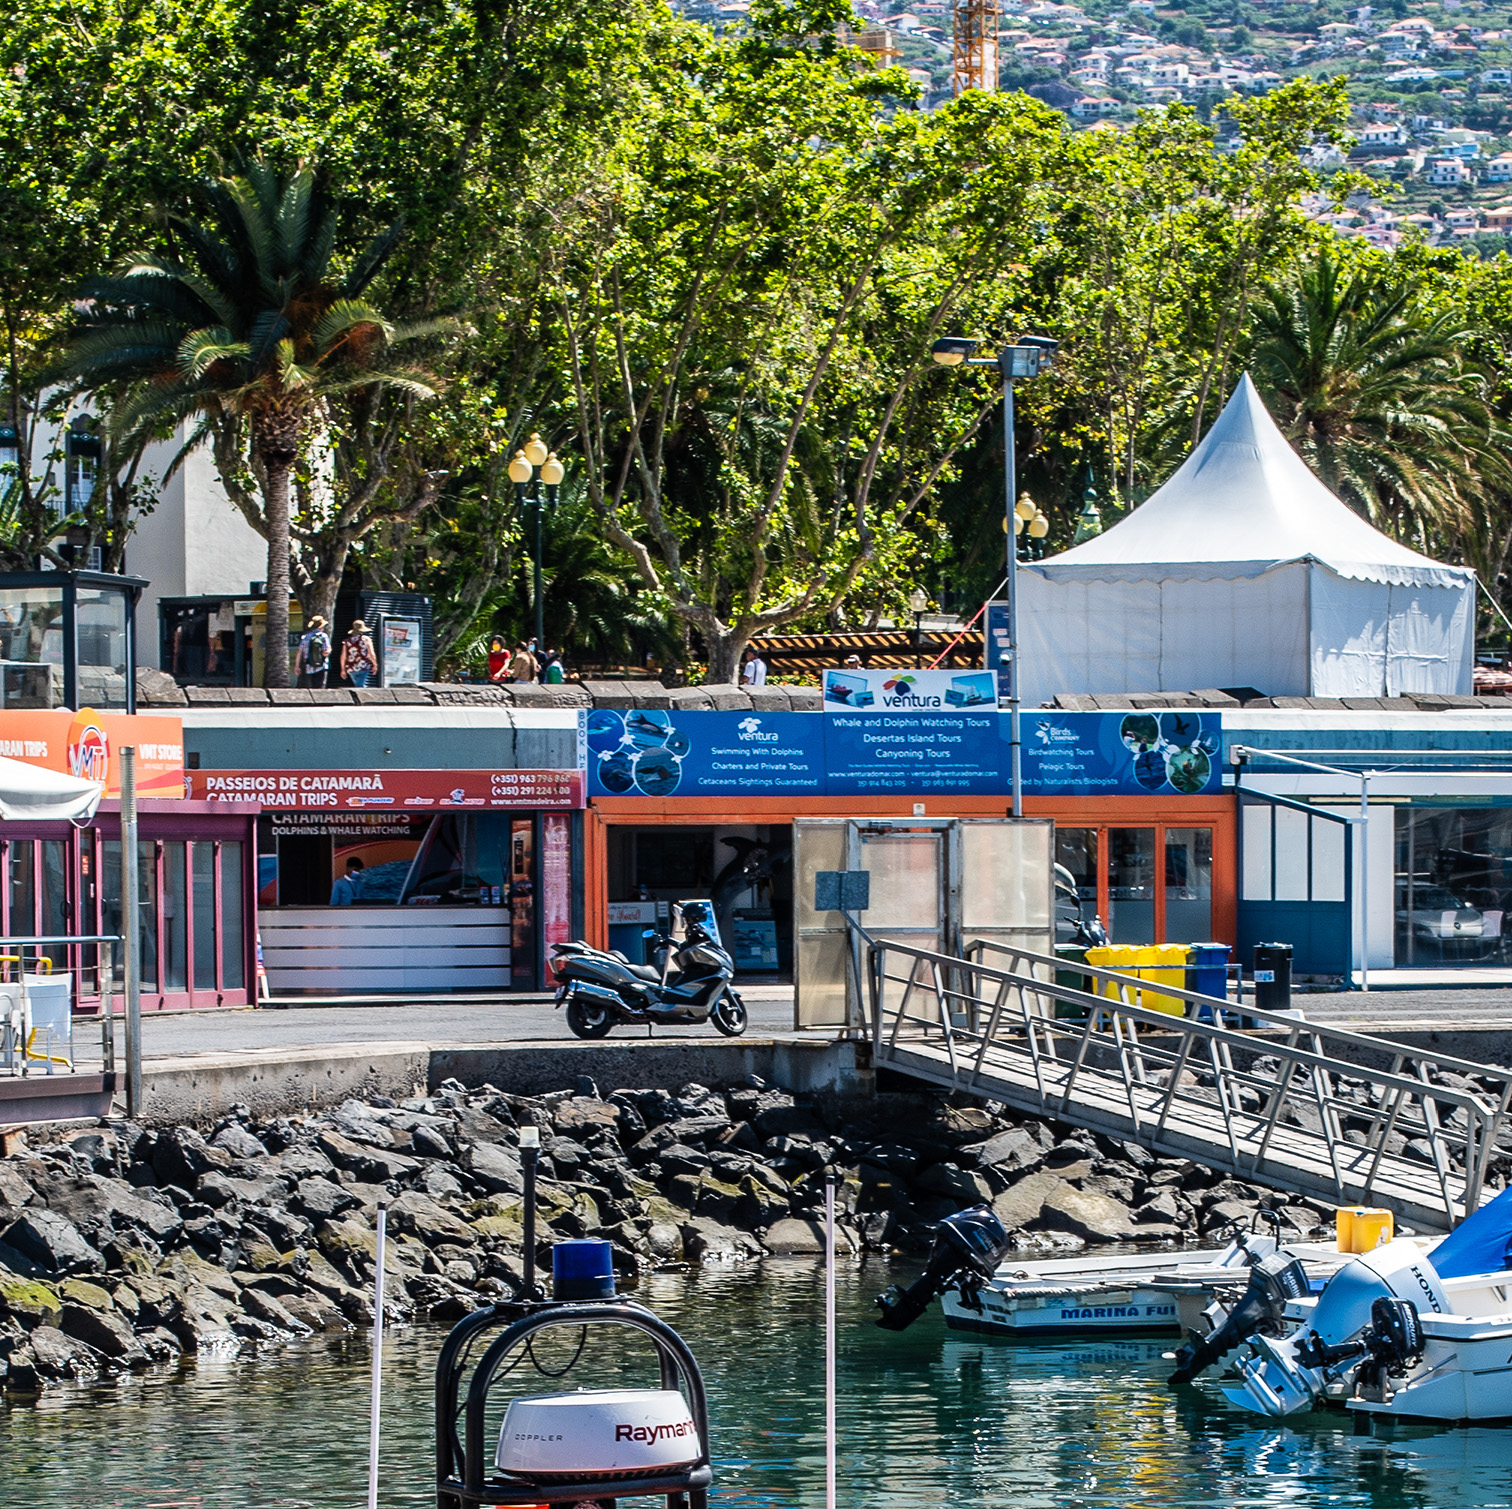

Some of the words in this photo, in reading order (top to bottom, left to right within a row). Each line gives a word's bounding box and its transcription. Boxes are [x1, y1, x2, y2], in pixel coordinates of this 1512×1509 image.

[883, 693, 942, 708] ventura
[833, 717, 862, 727] Whale
[864, 717, 881, 727] and
[884, 717, 919, 729] Dolphin
[921, 717, 964, 729] Watching
[966, 717, 991, 727] Tours
[738, 731, 779, 742] ventura
[1050, 727, 1071, 736] Birds
[863, 734, 905, 743] Desertas
[907, 733, 935, 743] Island
[937, 733, 962, 743] Tours
[24, 740, 48, 757] TRIPS
[139, 744, 157, 760] VMT
[158, 744, 183, 761] STORE
[711, 747, 752, 757] Swimming
[753, 748, 770, 756] With
[771, 748, 804, 757] Dolphins
[1028, 748, 1075, 757] Birdwatching
[1076, 748, 1095, 756] Tours
[875, 749, 924, 760] Canyoning
[926, 749, 951, 759] Tours
[711, 762, 744, 770] Charters
[745, 762, 759, 770] and
[761, 762, 787, 770] Private
[788, 763, 809, 771] Tours
[1039, 763, 1064, 771] Pelagic
[206, 776, 276, 791] PASSEIOS
[279, 776, 297, 790] DE
[300, 774, 384, 791] CATAMARÃ
[490, 774, 518, 784] (+351)
[519, 774, 535, 783] 963
[698, 777, 737, 786] Cetaceans
[738, 778, 773, 788] Sightings
[774, 778, 818, 787] Guaranteed
[1006, 778, 1033, 786] Gded
[1033, 778, 1043, 787] by
[491, 786, 519, 796] (+351)
[206, 793, 297, 806] CATAMARAN
[299, 793, 338, 806] TRIPS
[272, 814, 367, 824] CATAMARAN
[272, 826, 320, 836] DOLPHINS
[321, 826, 327, 835] &
[328, 826, 361, 835] WHALE
[362, 826, 410, 835] WATCHING
[1409, 1265, 1442, 1314] HOND
[1061, 1306, 1140, 1320] MARINA
[1401, 1303, 1417, 1348] MERCURY
[514, 1433, 564, 1442] DOPPLER
